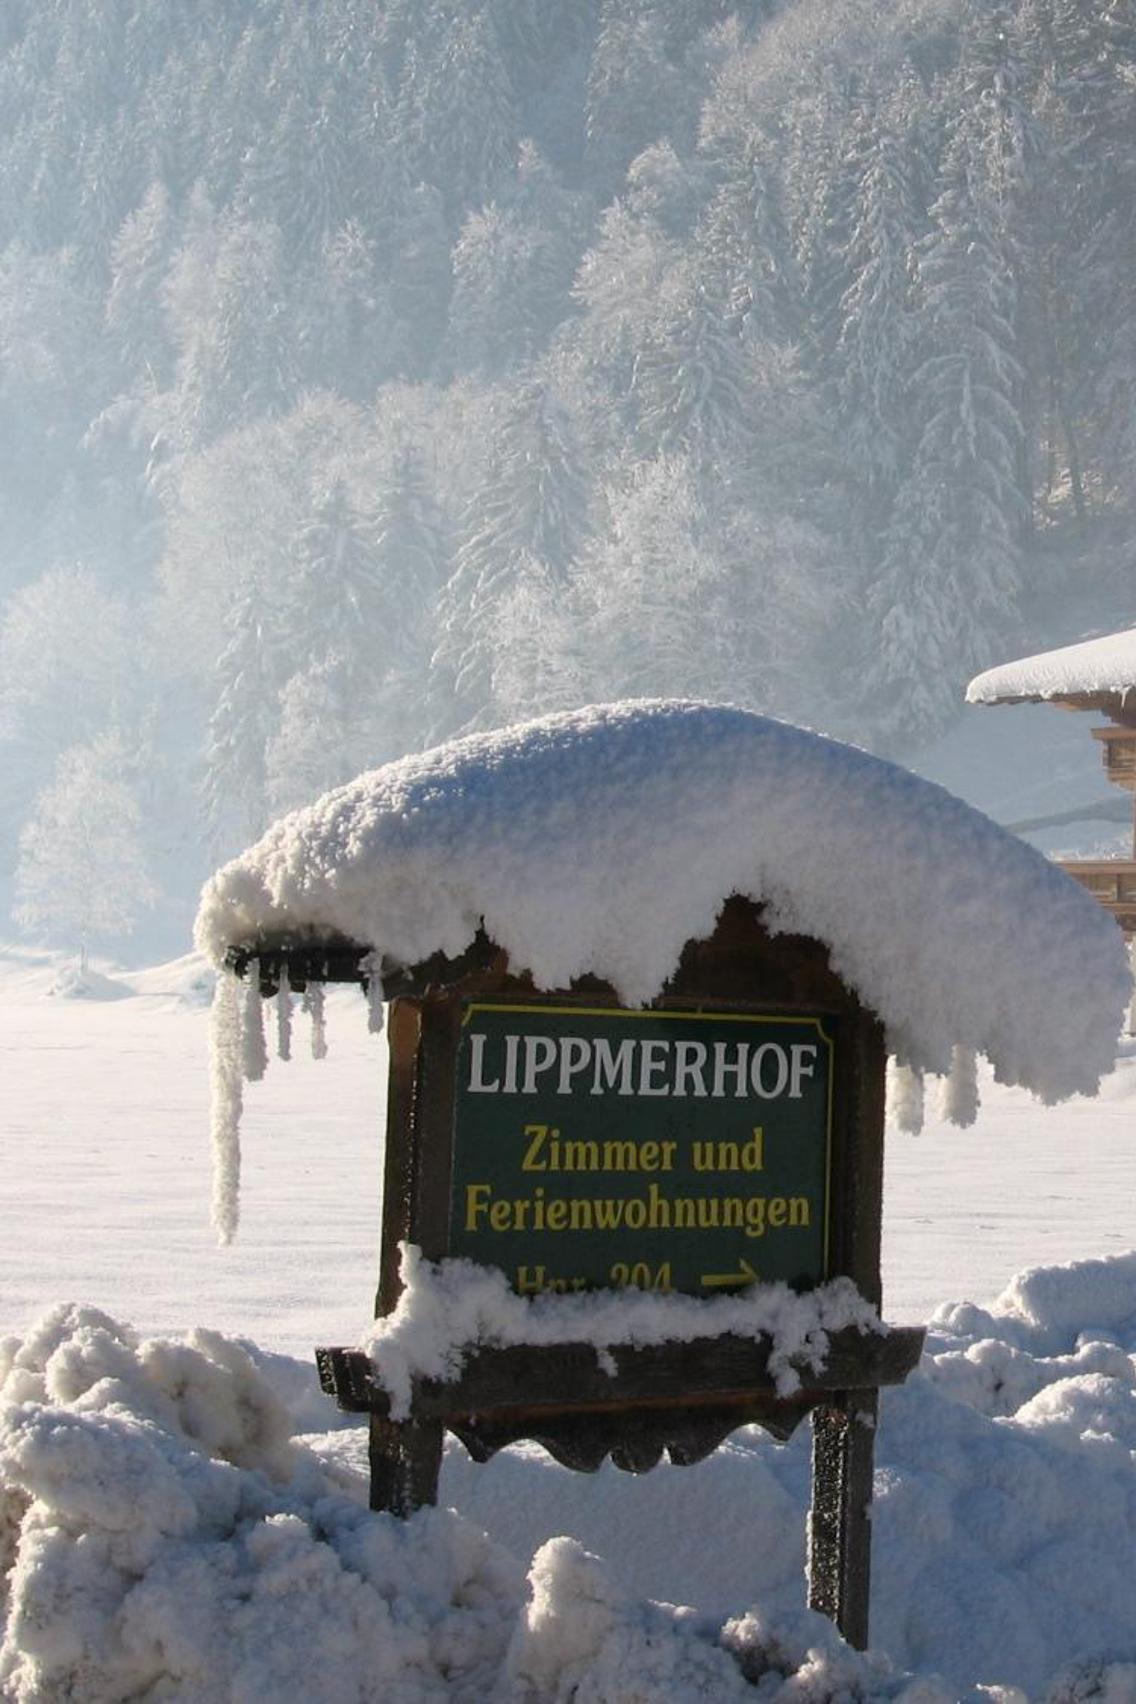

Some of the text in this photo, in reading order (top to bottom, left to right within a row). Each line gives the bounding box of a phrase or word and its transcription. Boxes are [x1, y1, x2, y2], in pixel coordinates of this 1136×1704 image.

[467, 1033, 817, 1099] LIPPMERHOF
[521, 1125, 764, 1172] Zimmer und
[465, 1183, 810, 1237] Ferienwohnungen
